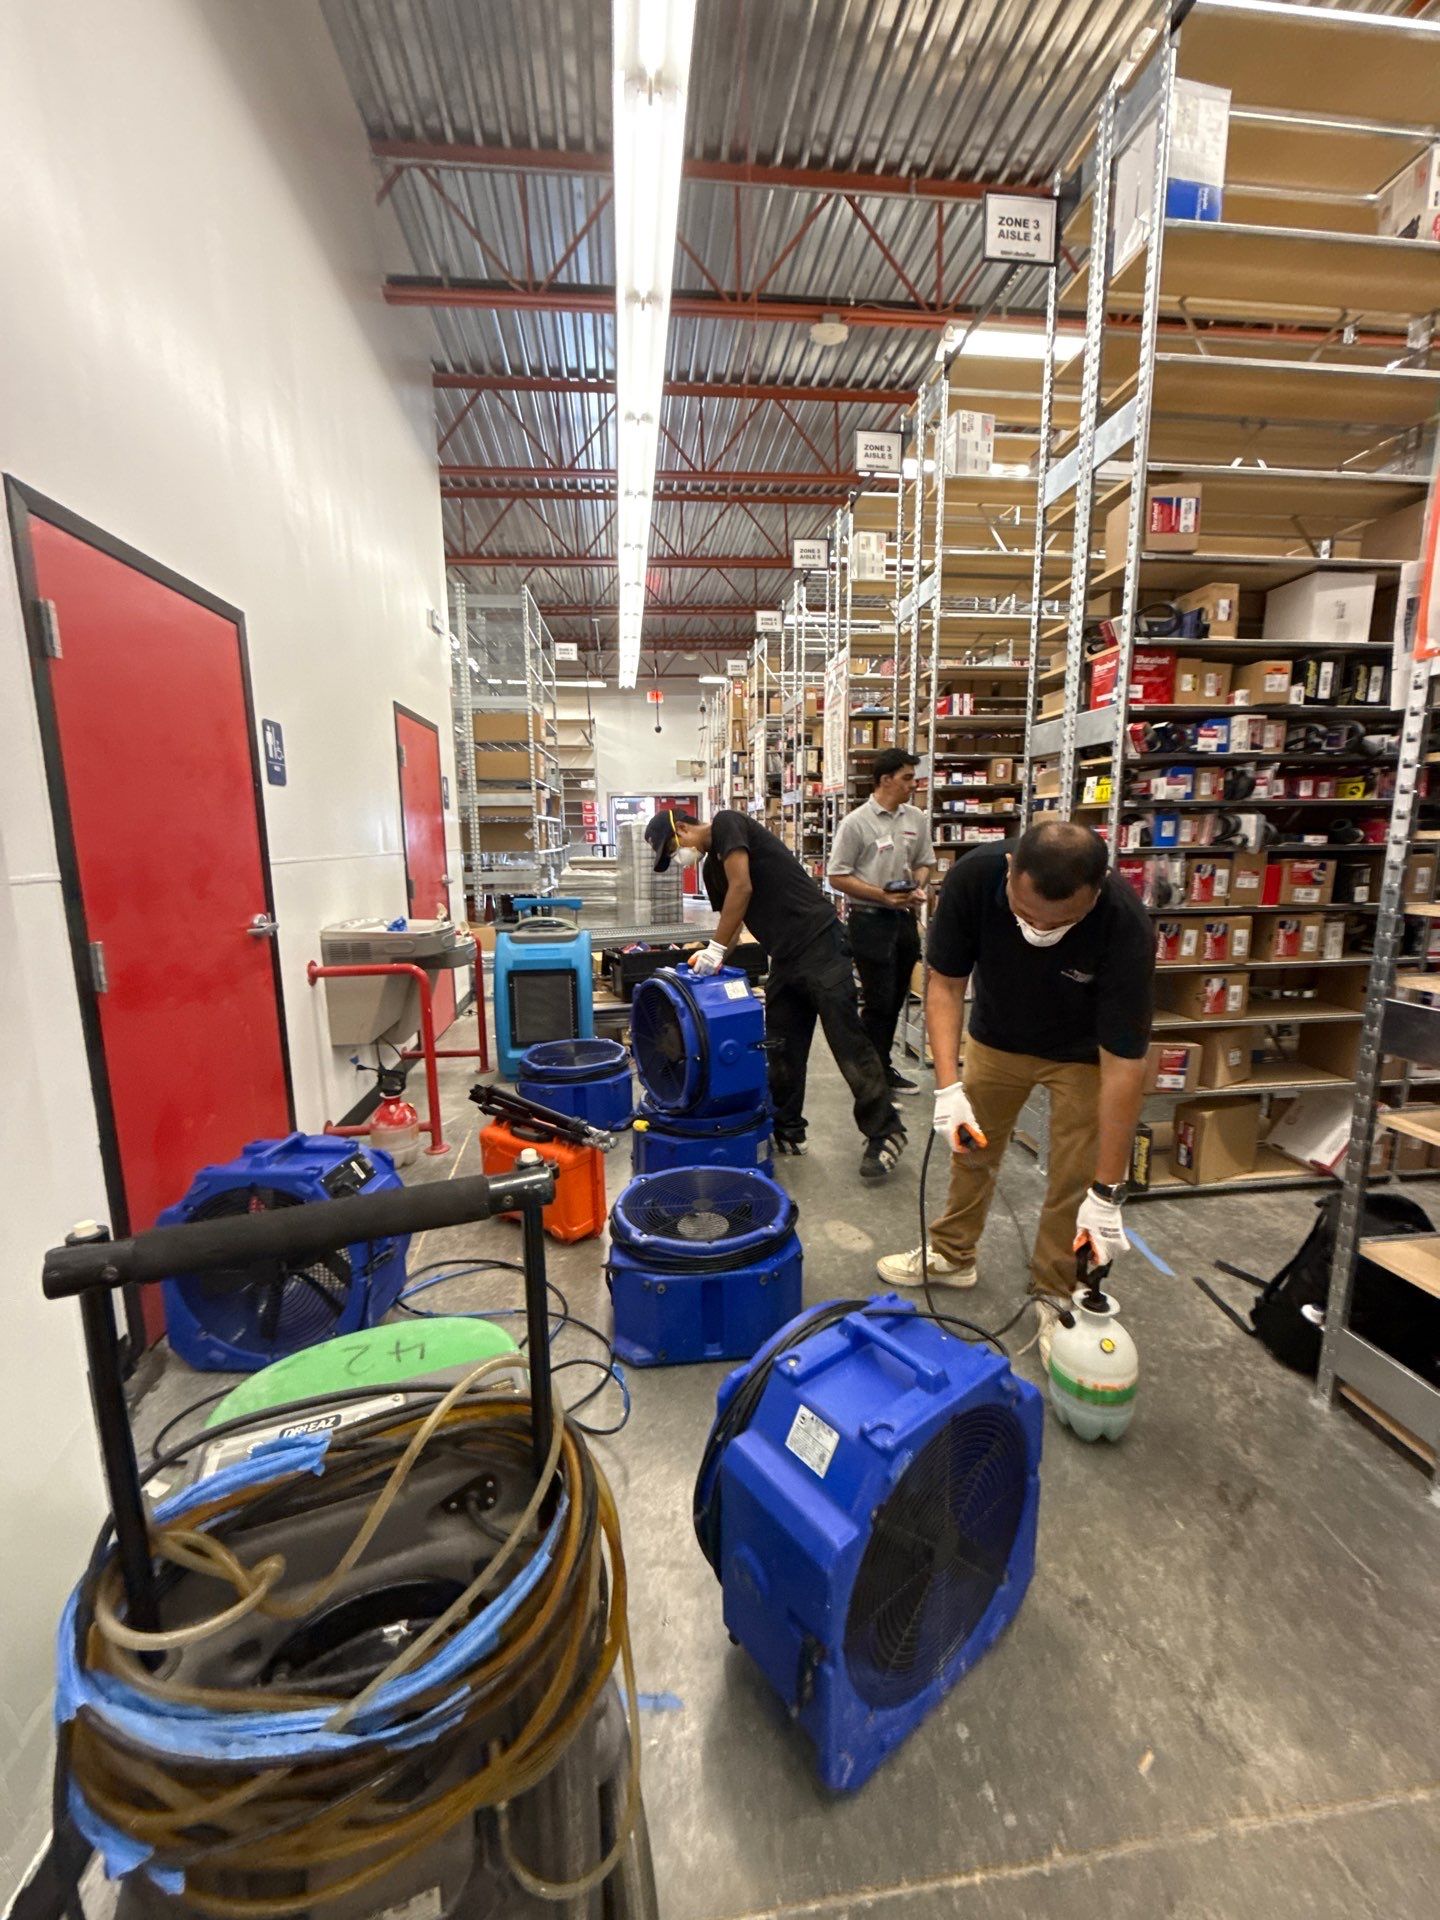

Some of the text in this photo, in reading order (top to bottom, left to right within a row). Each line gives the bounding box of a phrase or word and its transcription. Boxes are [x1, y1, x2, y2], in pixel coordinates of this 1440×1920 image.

[998, 216, 1040, 230] ZONE 3
[998, 229, 1042, 242] AISLE 4
[864, 444, 885, 452] ZONE
